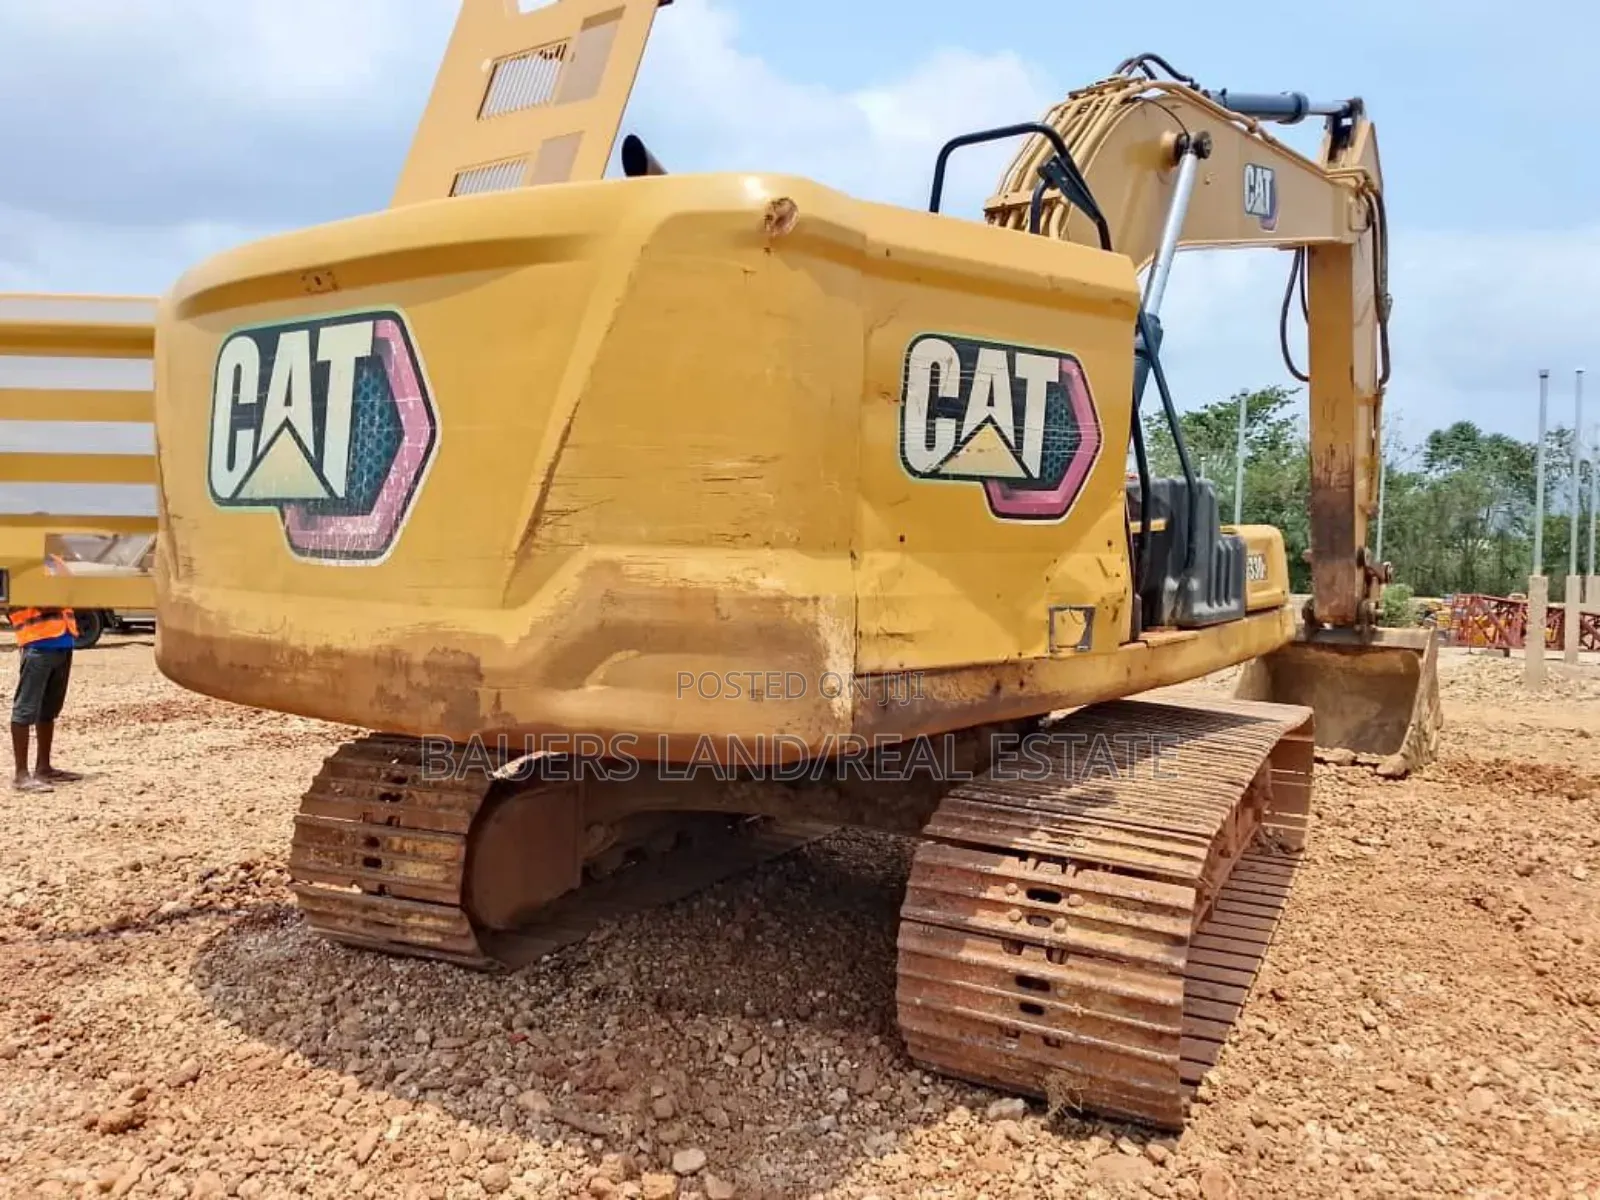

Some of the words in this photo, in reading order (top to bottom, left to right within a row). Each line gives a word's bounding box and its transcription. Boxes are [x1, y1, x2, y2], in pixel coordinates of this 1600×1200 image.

[1244, 163, 1272, 216] CAT
[210, 320, 374, 499] CAT
[904, 337, 1060, 479] CAT
